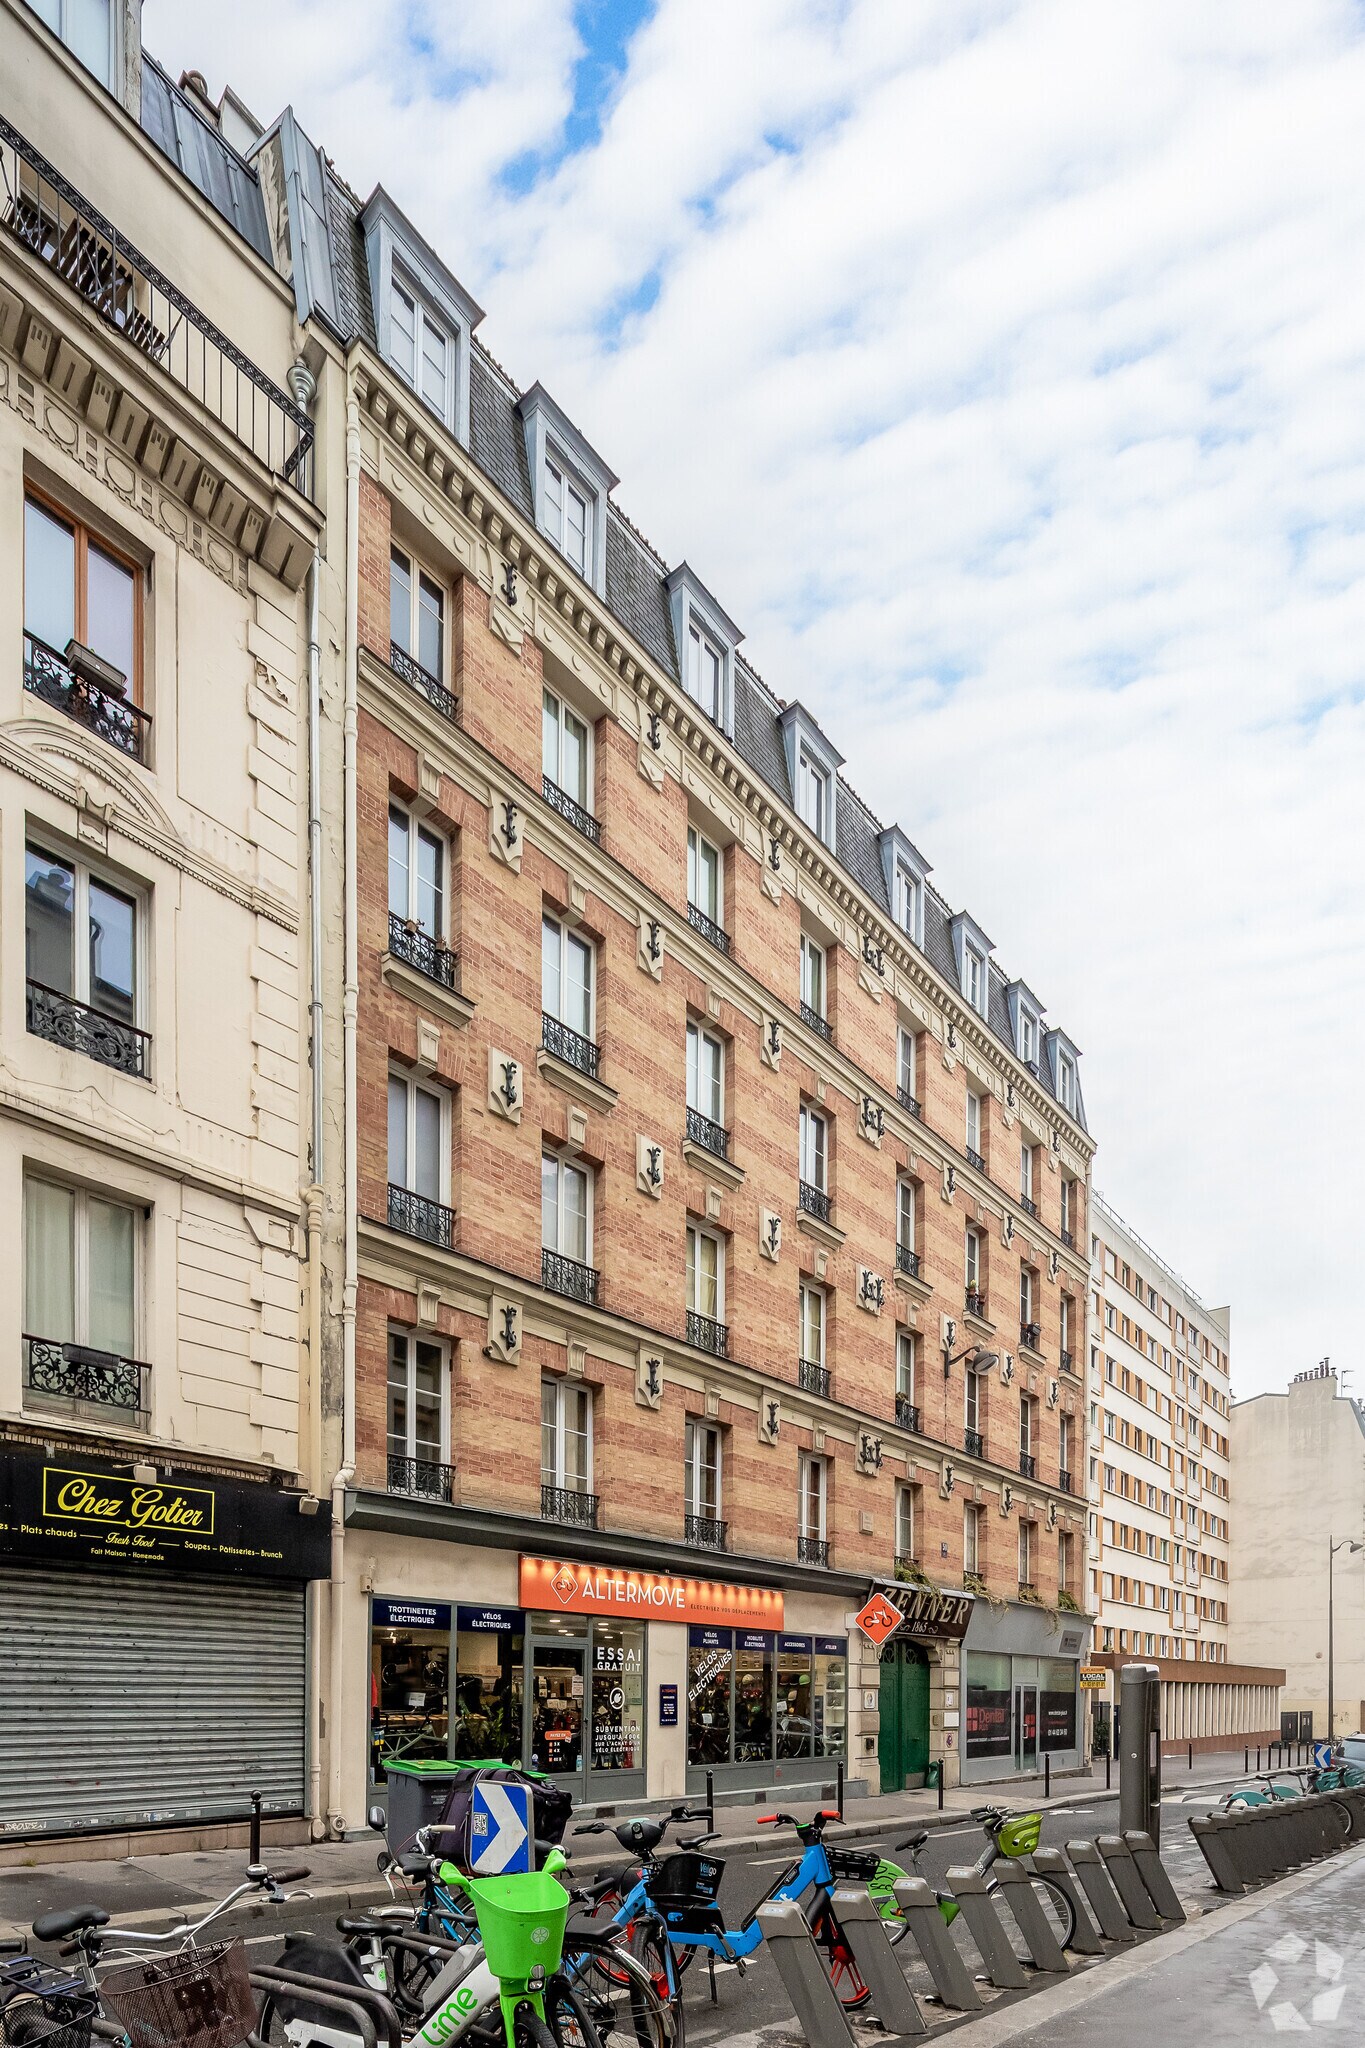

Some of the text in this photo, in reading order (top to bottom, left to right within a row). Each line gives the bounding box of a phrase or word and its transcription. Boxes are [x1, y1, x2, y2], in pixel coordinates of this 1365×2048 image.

[57, 1478, 204, 1529] Chez Gotier
[20, 1524, 43, 1535] Plats
[45, 1528, 78, 1538] chauds
[105, 1532, 156, 1549] Fresh Food
[90, 1547, 165, 1561] Fait Maison Homemade
[184, 1540, 211, 1551] Soupes
[260, 1550, 283, 1559] Brunch
[582, 1577, 686, 1608] ALTERMOVE
[388, 1605, 437, 1616] TROTTINETTES
[883, 1587, 969, 1624] ZENNER
[390, 1614, 435, 1624] ÉLECTRIQUES
[482, 1612, 502, 1620] VÉLOS
[472, 1620, 511, 1629] ÉLECTRIQUES
[911, 1621, 928, 1632] 1865
[597, 1646, 641, 1661] ESSAI
[597, 1661, 641, 1672] GRATUIT
[979, 1708, 1005, 1724] Dental
[595, 1725, 640, 1733] SUBVENTION
